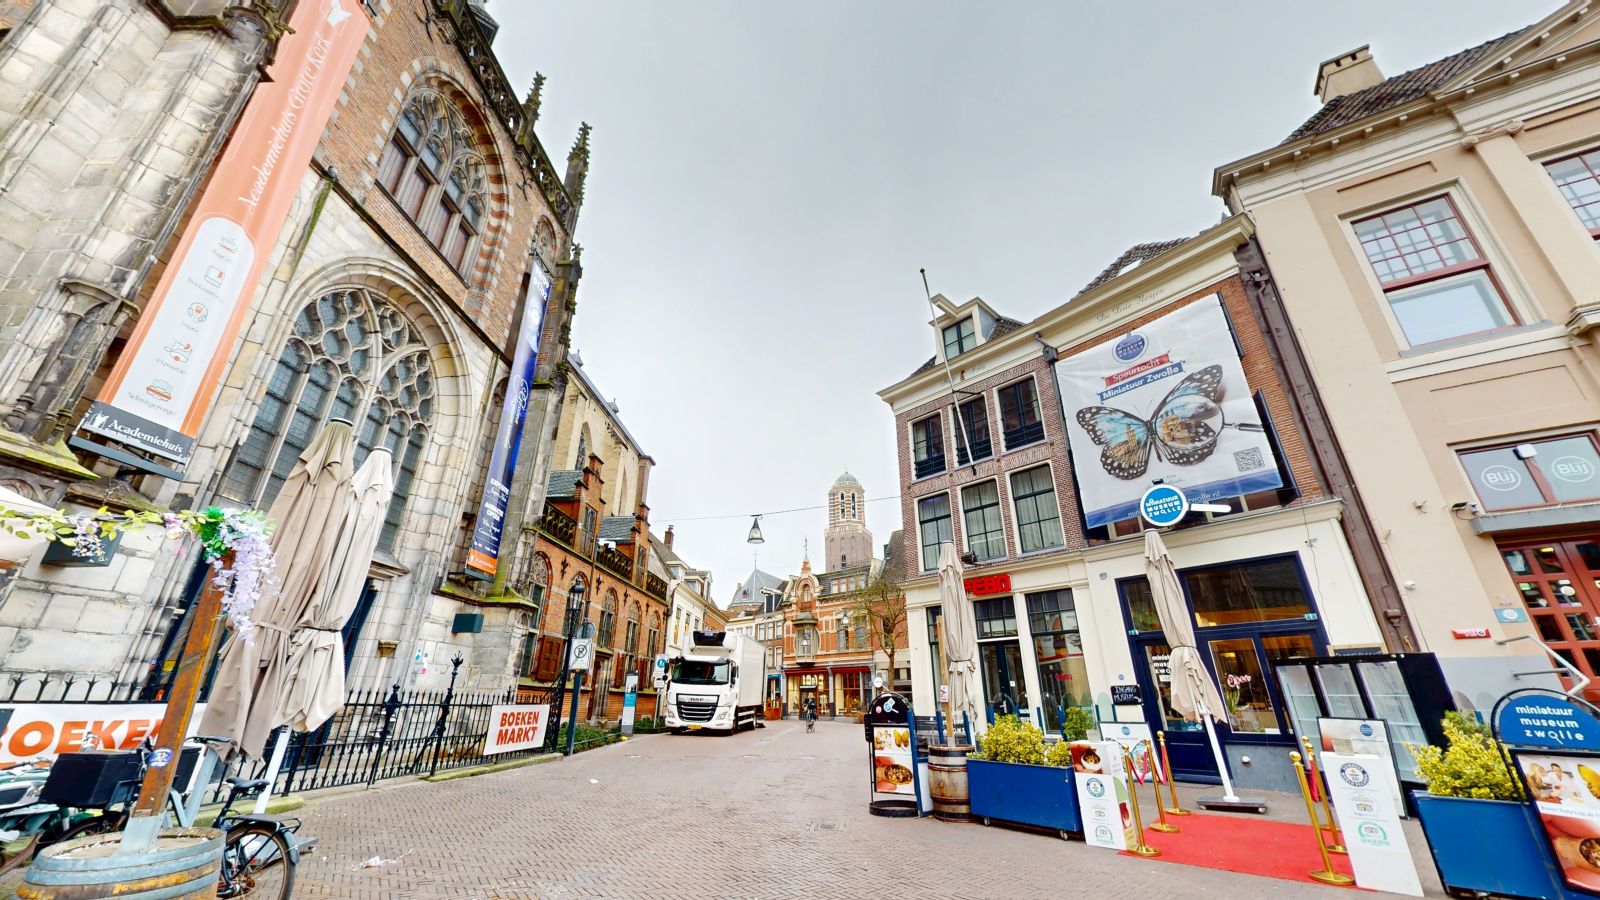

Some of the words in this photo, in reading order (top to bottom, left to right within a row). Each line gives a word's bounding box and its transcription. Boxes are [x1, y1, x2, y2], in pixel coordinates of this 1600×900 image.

[238, 110, 297, 209] Academiehuis
[1112, 358, 1162, 383] Speurtocht
[1103, 379, 1144, 400] Miniatuur
[1146, 366, 1179, 384] Zwolle
[108, 419, 184, 454] Academiehuis
[1556, 461, 1589, 475] Blij
[1486, 470, 1516, 483] Blij
[1147, 501, 1181, 512] MUSEUM
[1149, 506, 1182, 518] ZWOLLE
[1114, 693, 1135, 702] MUSEUM
[1515, 705, 1574, 716] miniatuur
[500, 711, 540, 727] BOEKEN
[1520, 717, 1579, 728] museum
[0, 719, 163, 757] OEKE
[496, 726, 538, 746] MARKT
[1525, 729, 1584, 744] zwolle
